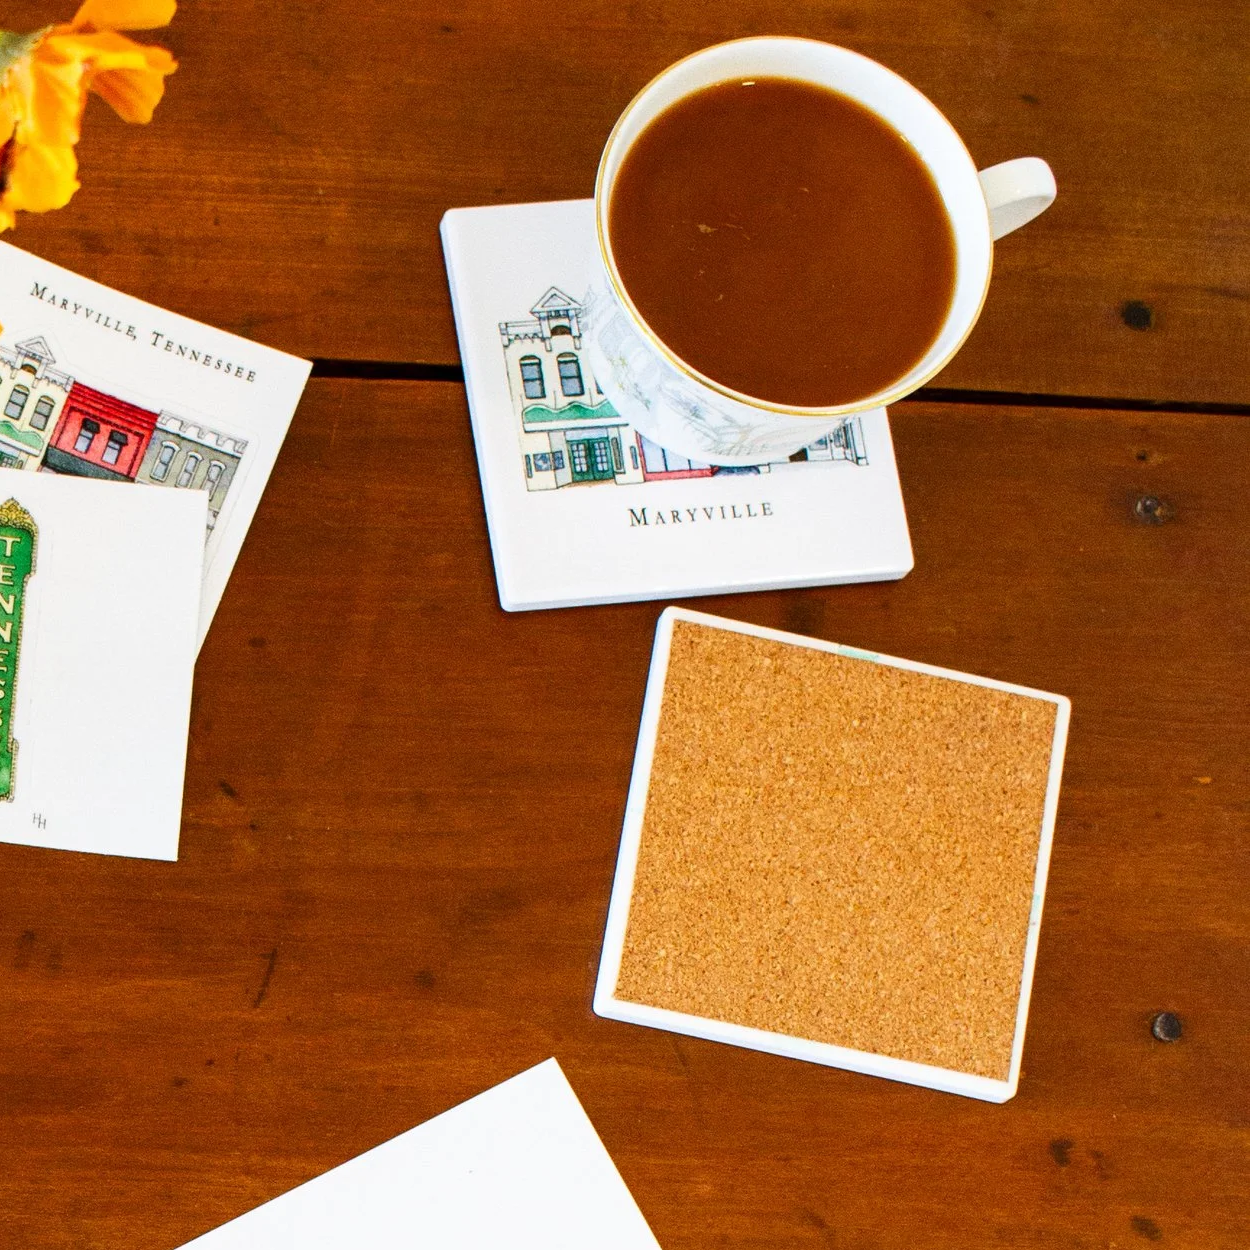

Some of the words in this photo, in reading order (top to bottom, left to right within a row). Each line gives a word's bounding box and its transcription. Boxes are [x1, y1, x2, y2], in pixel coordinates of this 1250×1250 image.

[29, 281, 138, 341] MARYVILLE,
[149, 330, 257, 383] TENNESSEE
[627, 501, 774, 528] MARYVILLE
